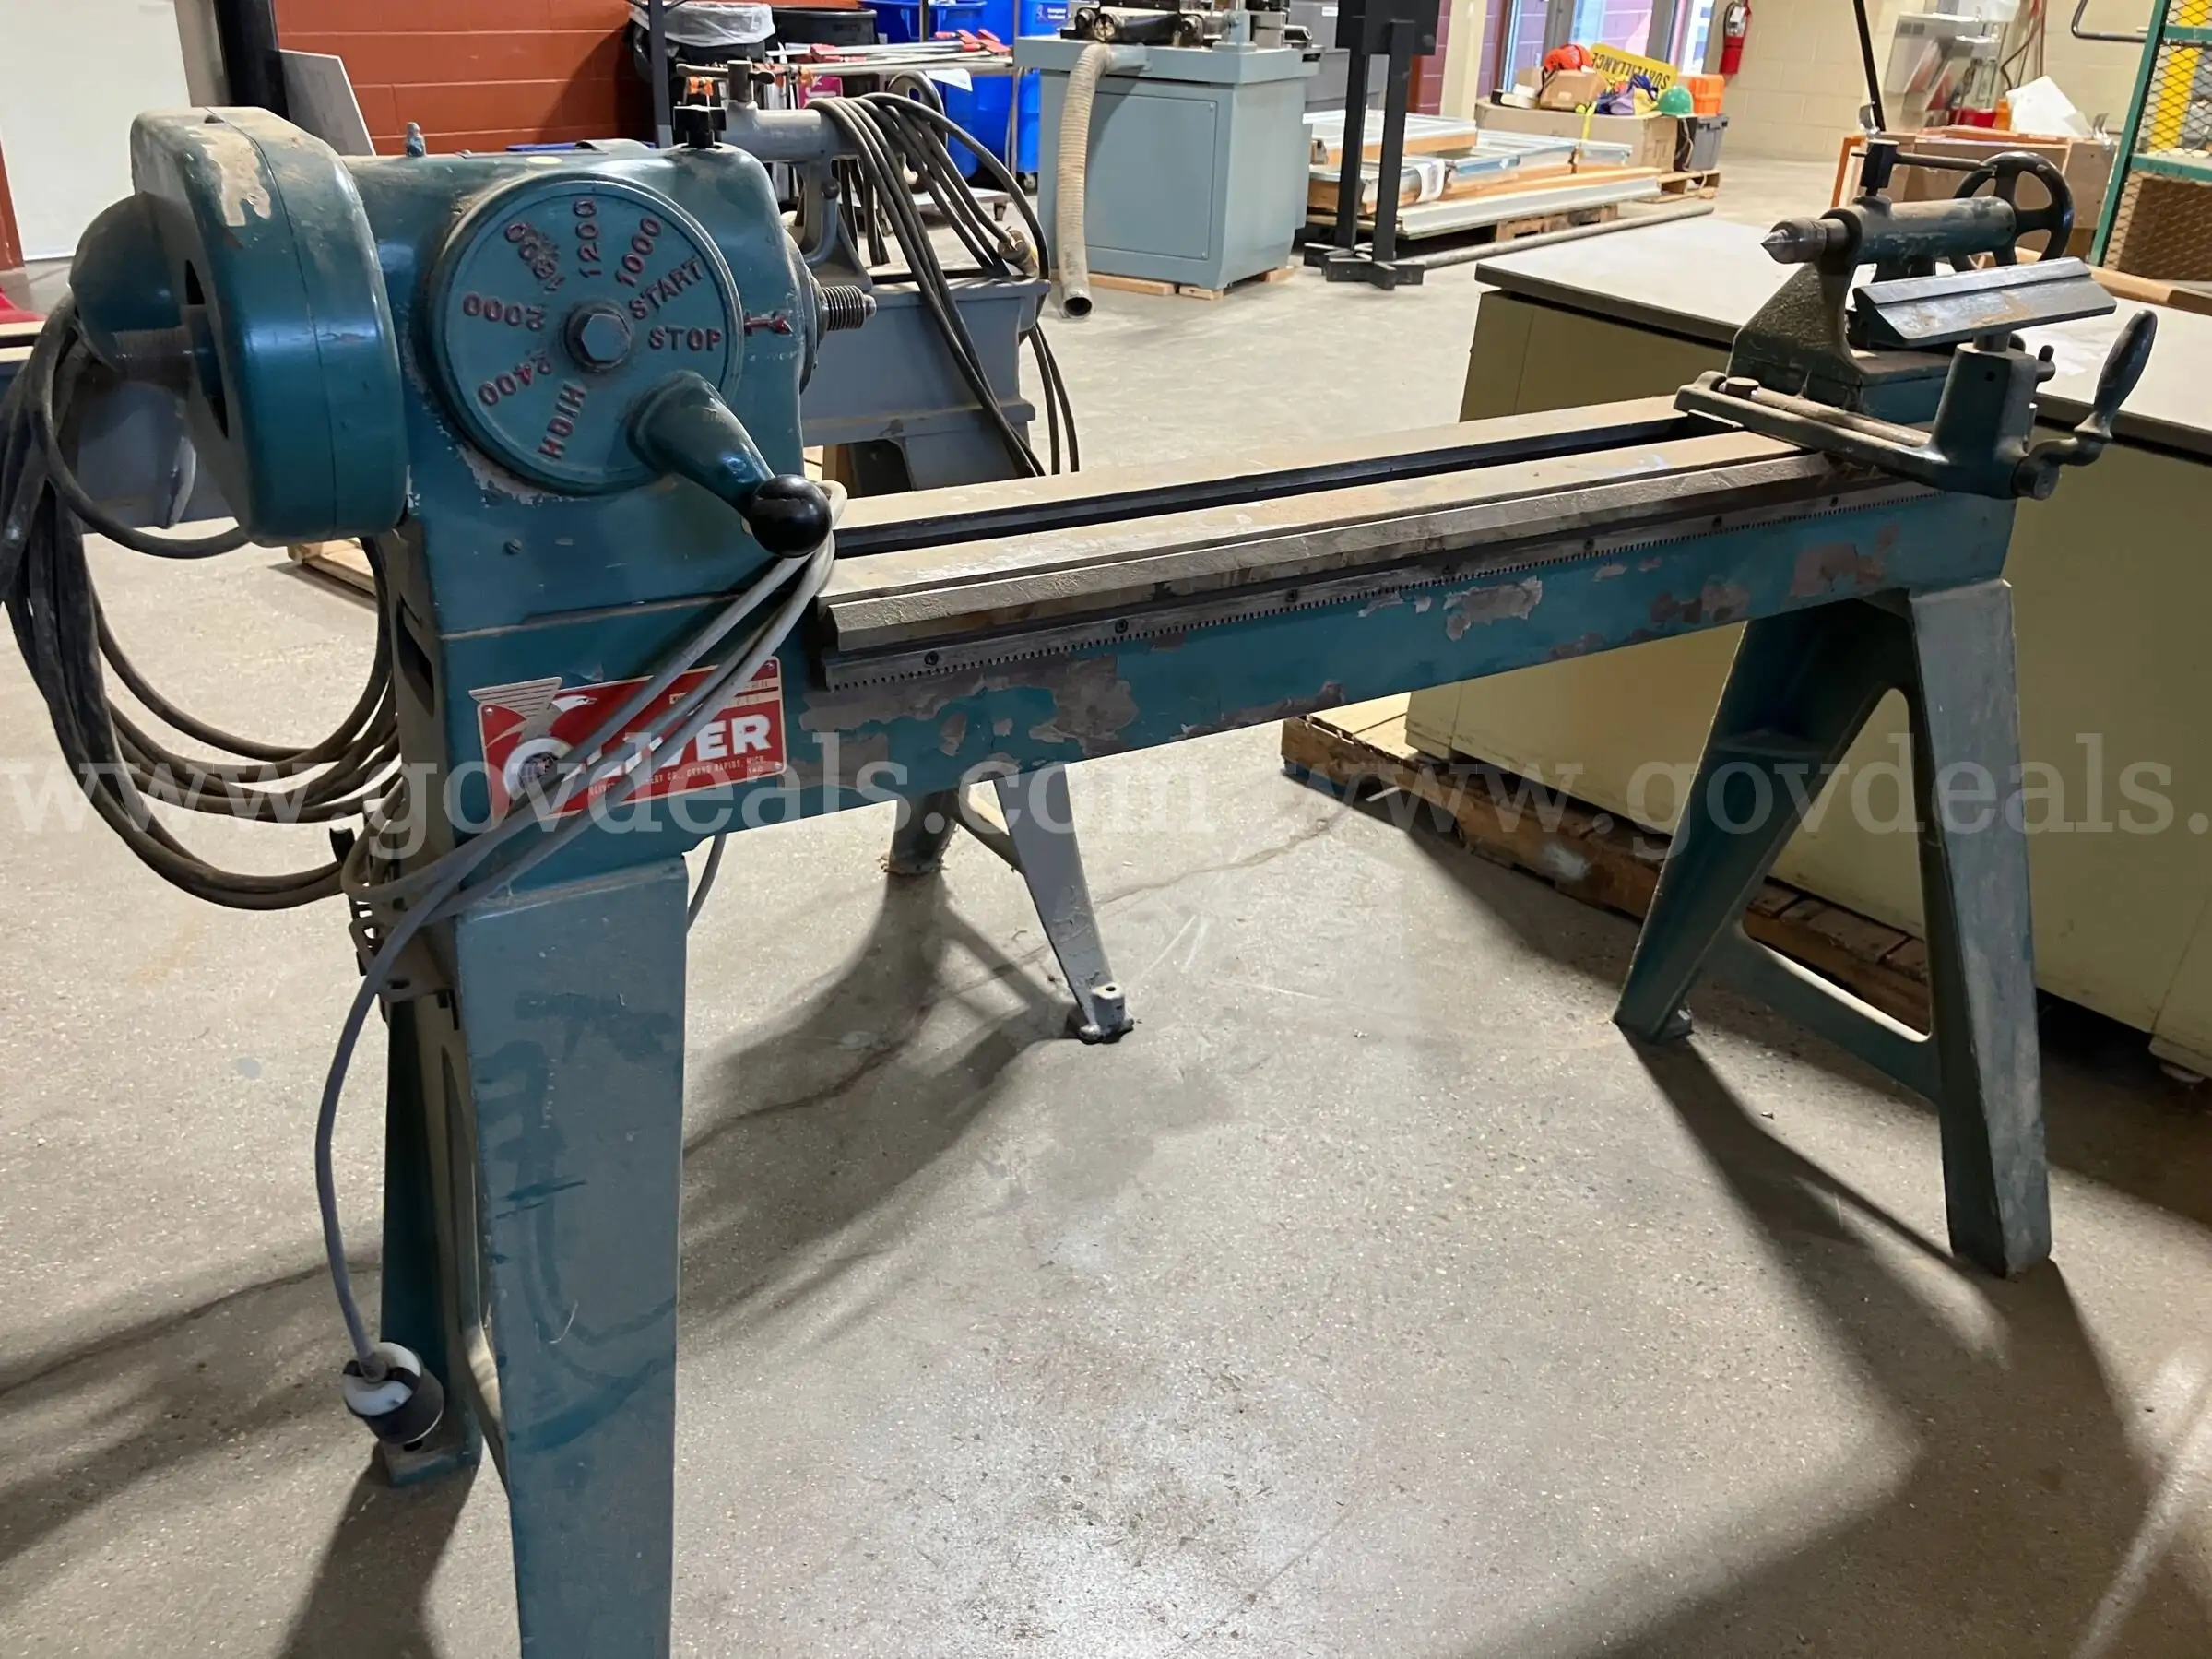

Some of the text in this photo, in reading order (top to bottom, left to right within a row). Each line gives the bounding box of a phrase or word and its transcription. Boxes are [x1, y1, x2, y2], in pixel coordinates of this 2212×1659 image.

[574, 199, 601, 278] 1200
[615, 217, 662, 289] 1000
[463, 292, 545, 332] 2000
[629, 256, 704, 320] START
[648, 326, 722, 352] STOP
[478, 350, 552, 407] 2400
[538, 381, 586, 460] HIGH
[503, 714, 772, 802] OER
